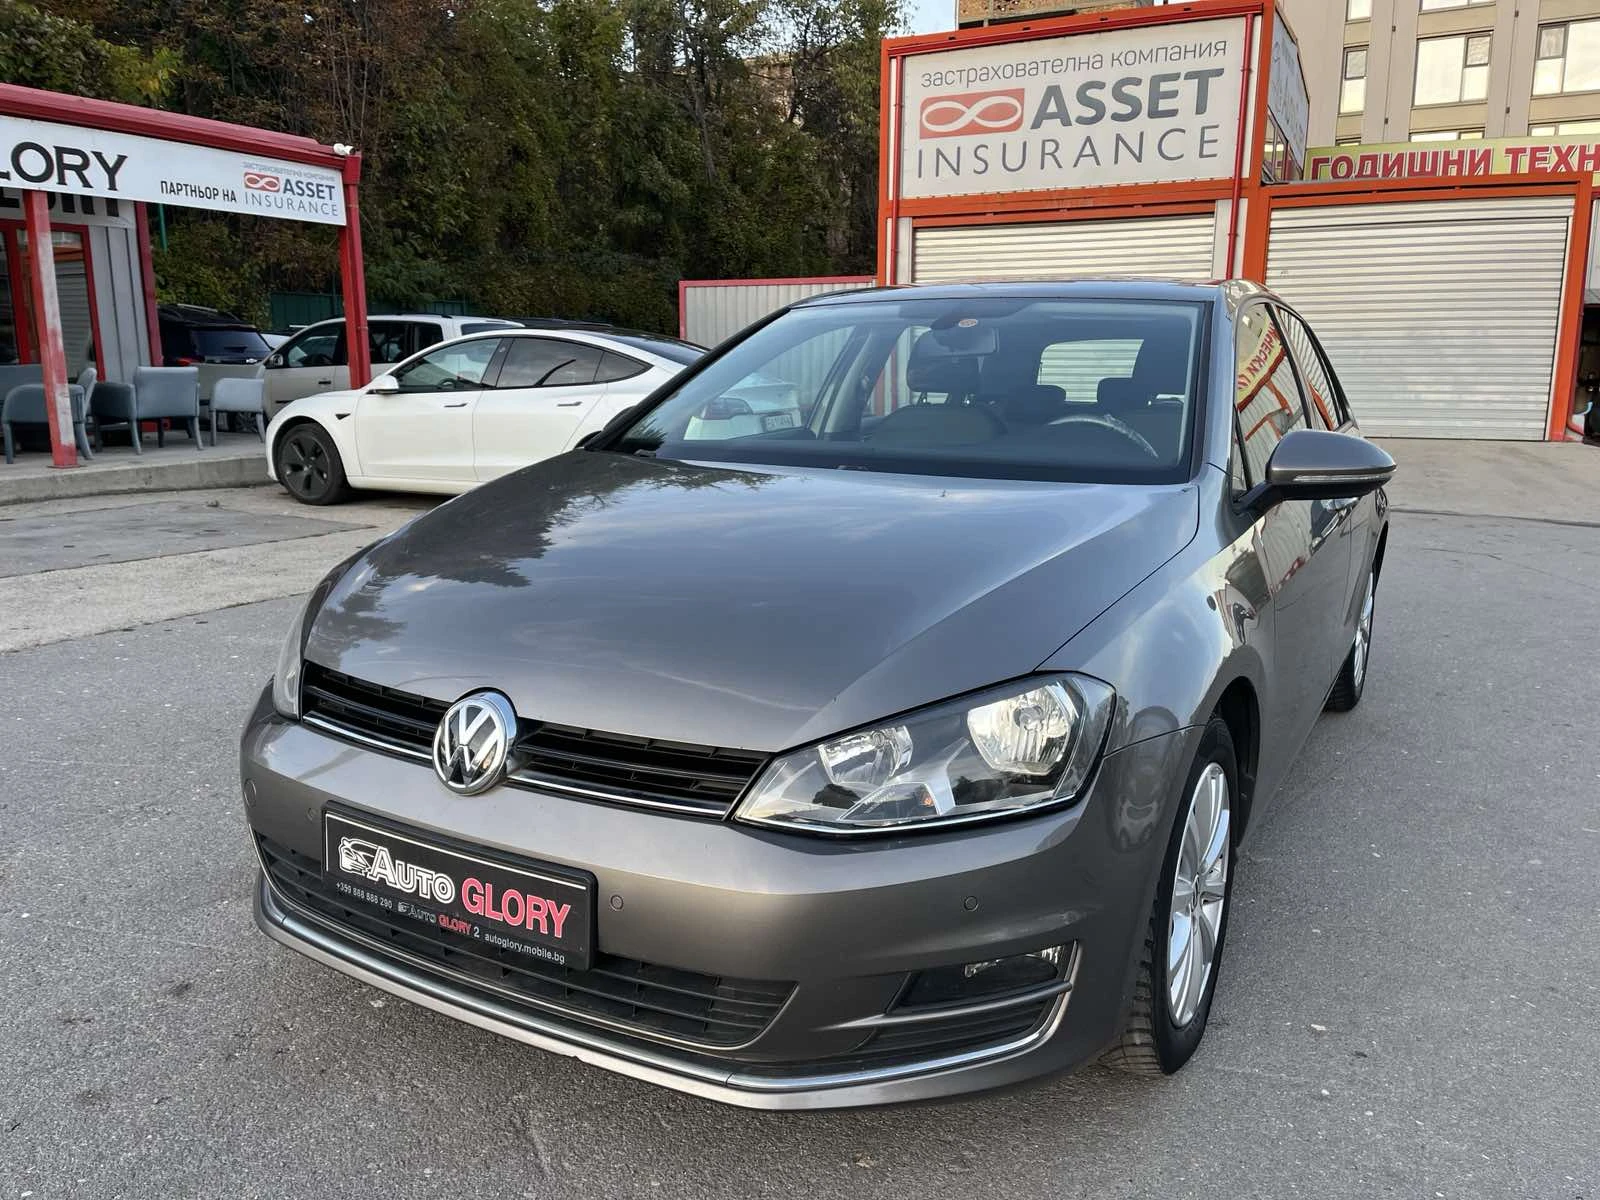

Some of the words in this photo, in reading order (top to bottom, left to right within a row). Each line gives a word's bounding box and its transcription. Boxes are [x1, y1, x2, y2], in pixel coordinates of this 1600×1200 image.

[921, 53, 1104, 88] застрахователна
[1111, 40, 1227, 67] компания
[1030, 68, 1225, 129] ASSET
[917, 124, 1220, 178] INSURANCE
[1311, 148, 1492, 181] ГОДИШНИ
[161, 181, 219, 200] ПАРТНЬОР
[222, 188, 237, 202] НА
[244, 192, 339, 216] INSURANCE
[283, 178, 335, 200] ASSET
[461, 877, 572, 939] GLORY
[438, 914, 472, 937] GLORY
[473, 926, 480, 938] 2
[484, 932, 565, 965] autoglory.mobile.bg
